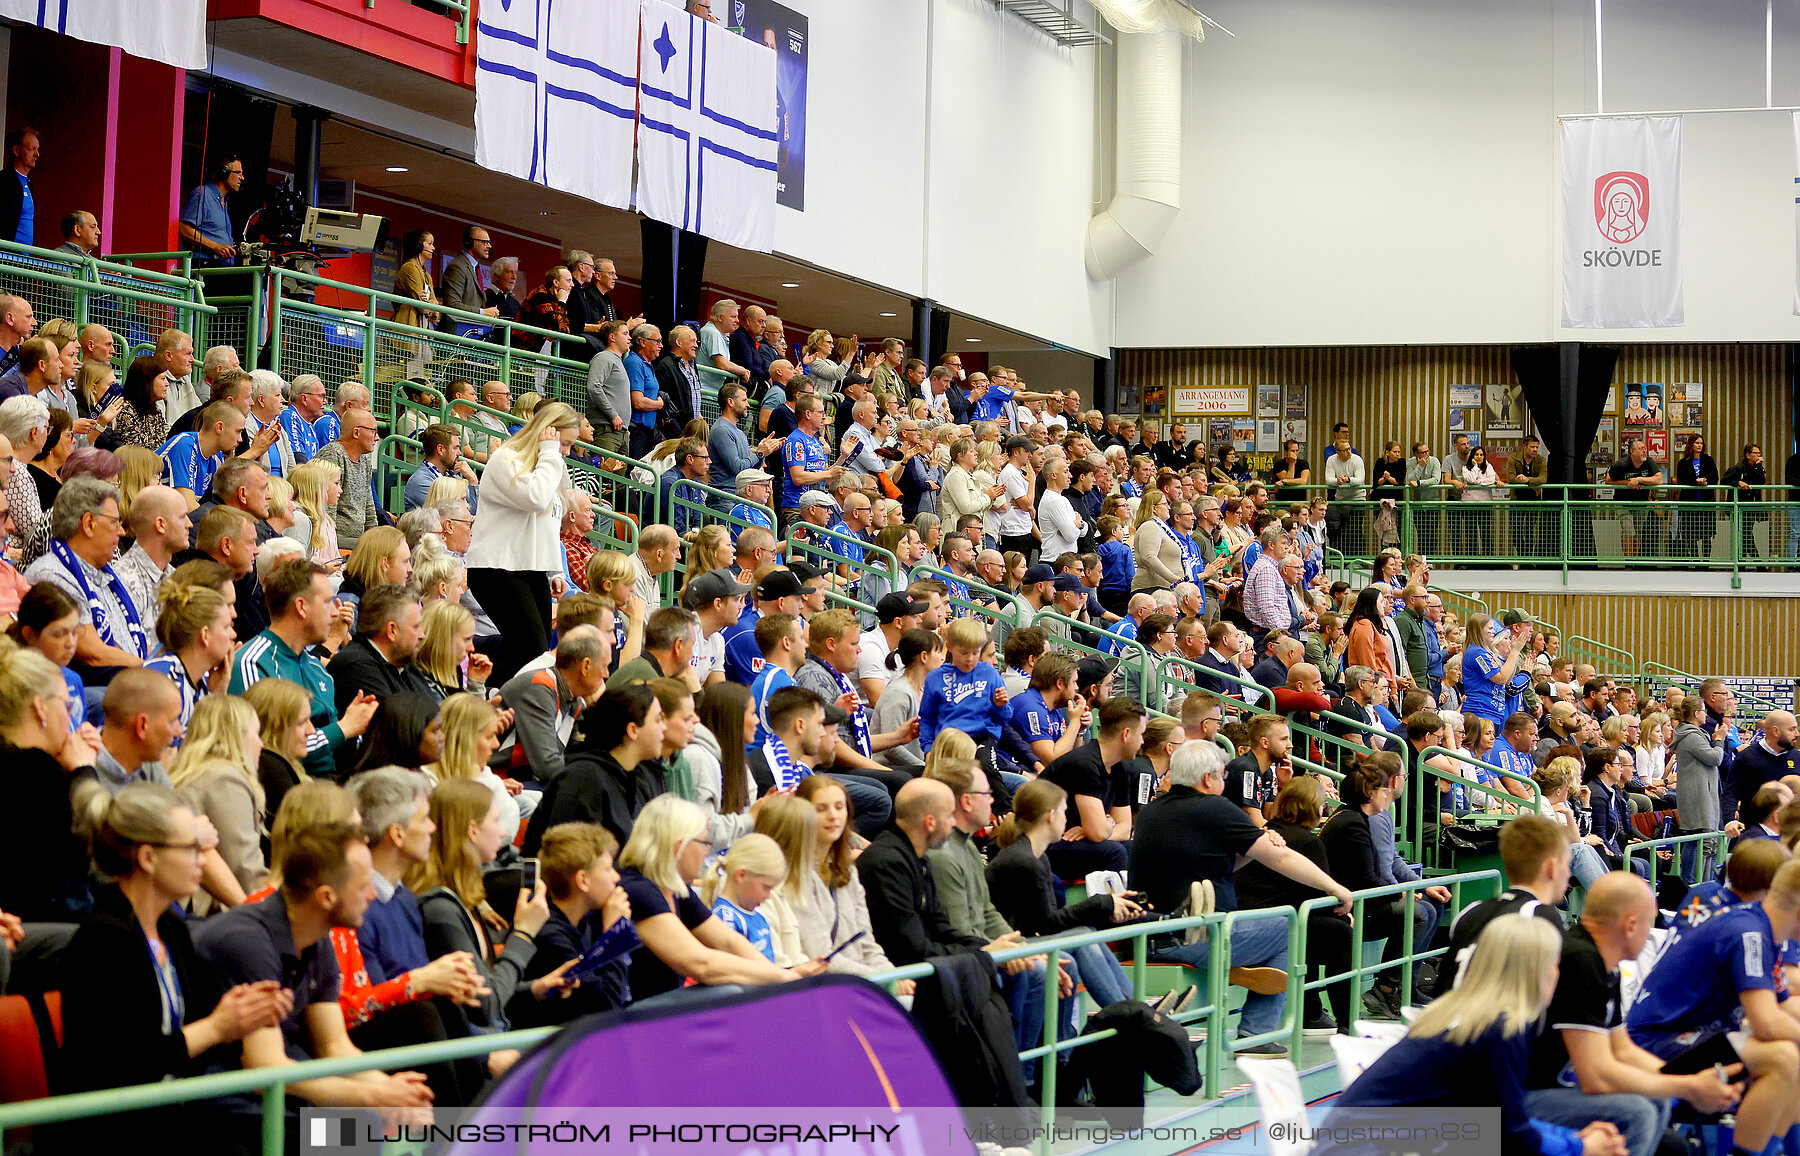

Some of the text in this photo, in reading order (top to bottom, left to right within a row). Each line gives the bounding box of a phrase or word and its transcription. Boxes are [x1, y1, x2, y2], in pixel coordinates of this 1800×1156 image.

[789, 39, 802, 54] 567
[1583, 246, 1662, 267] SKÖVDE
[1178, 390, 1245, 401] ARRANGEMANG
[1197, 401, 1227, 410] 2006
